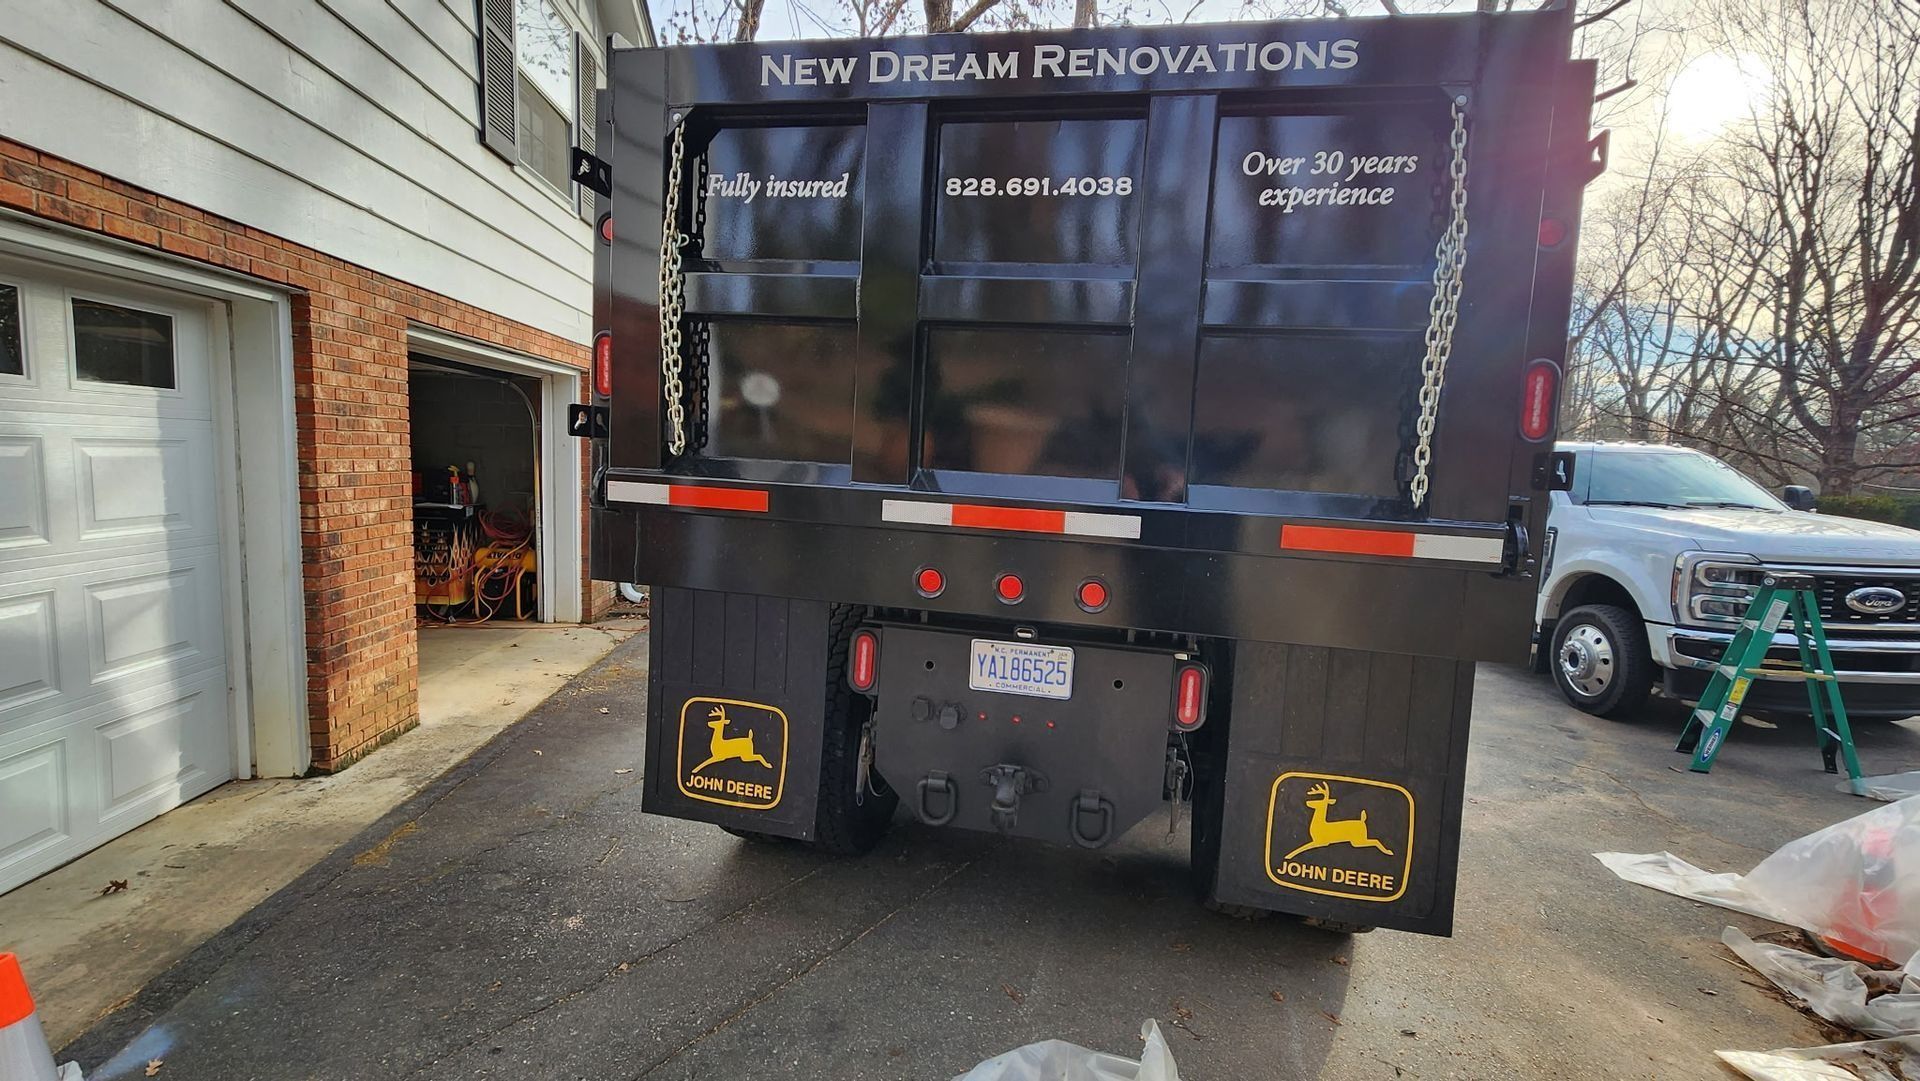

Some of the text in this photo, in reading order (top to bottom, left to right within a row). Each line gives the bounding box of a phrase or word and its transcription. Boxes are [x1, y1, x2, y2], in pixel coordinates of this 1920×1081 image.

[760, 39, 1360, 86] NEW DREAM RENOVATIONS
[1242, 150, 1418, 182] Over 30 years
[705, 172, 850, 204] Fully insured
[945, 176, 1133, 196] 828.691.4038
[1258, 181, 1395, 213] experience
[1865, 594, 1894, 607] Ford
[1010, 648, 1051, 657] PERMANENT
[977, 653, 1067, 686] YA186525
[995, 682, 1046, 693] COMMERCIAL
[686, 775, 773, 800] JOHN DEERE
[1277, 861, 1394, 891] JOHN DEERE
